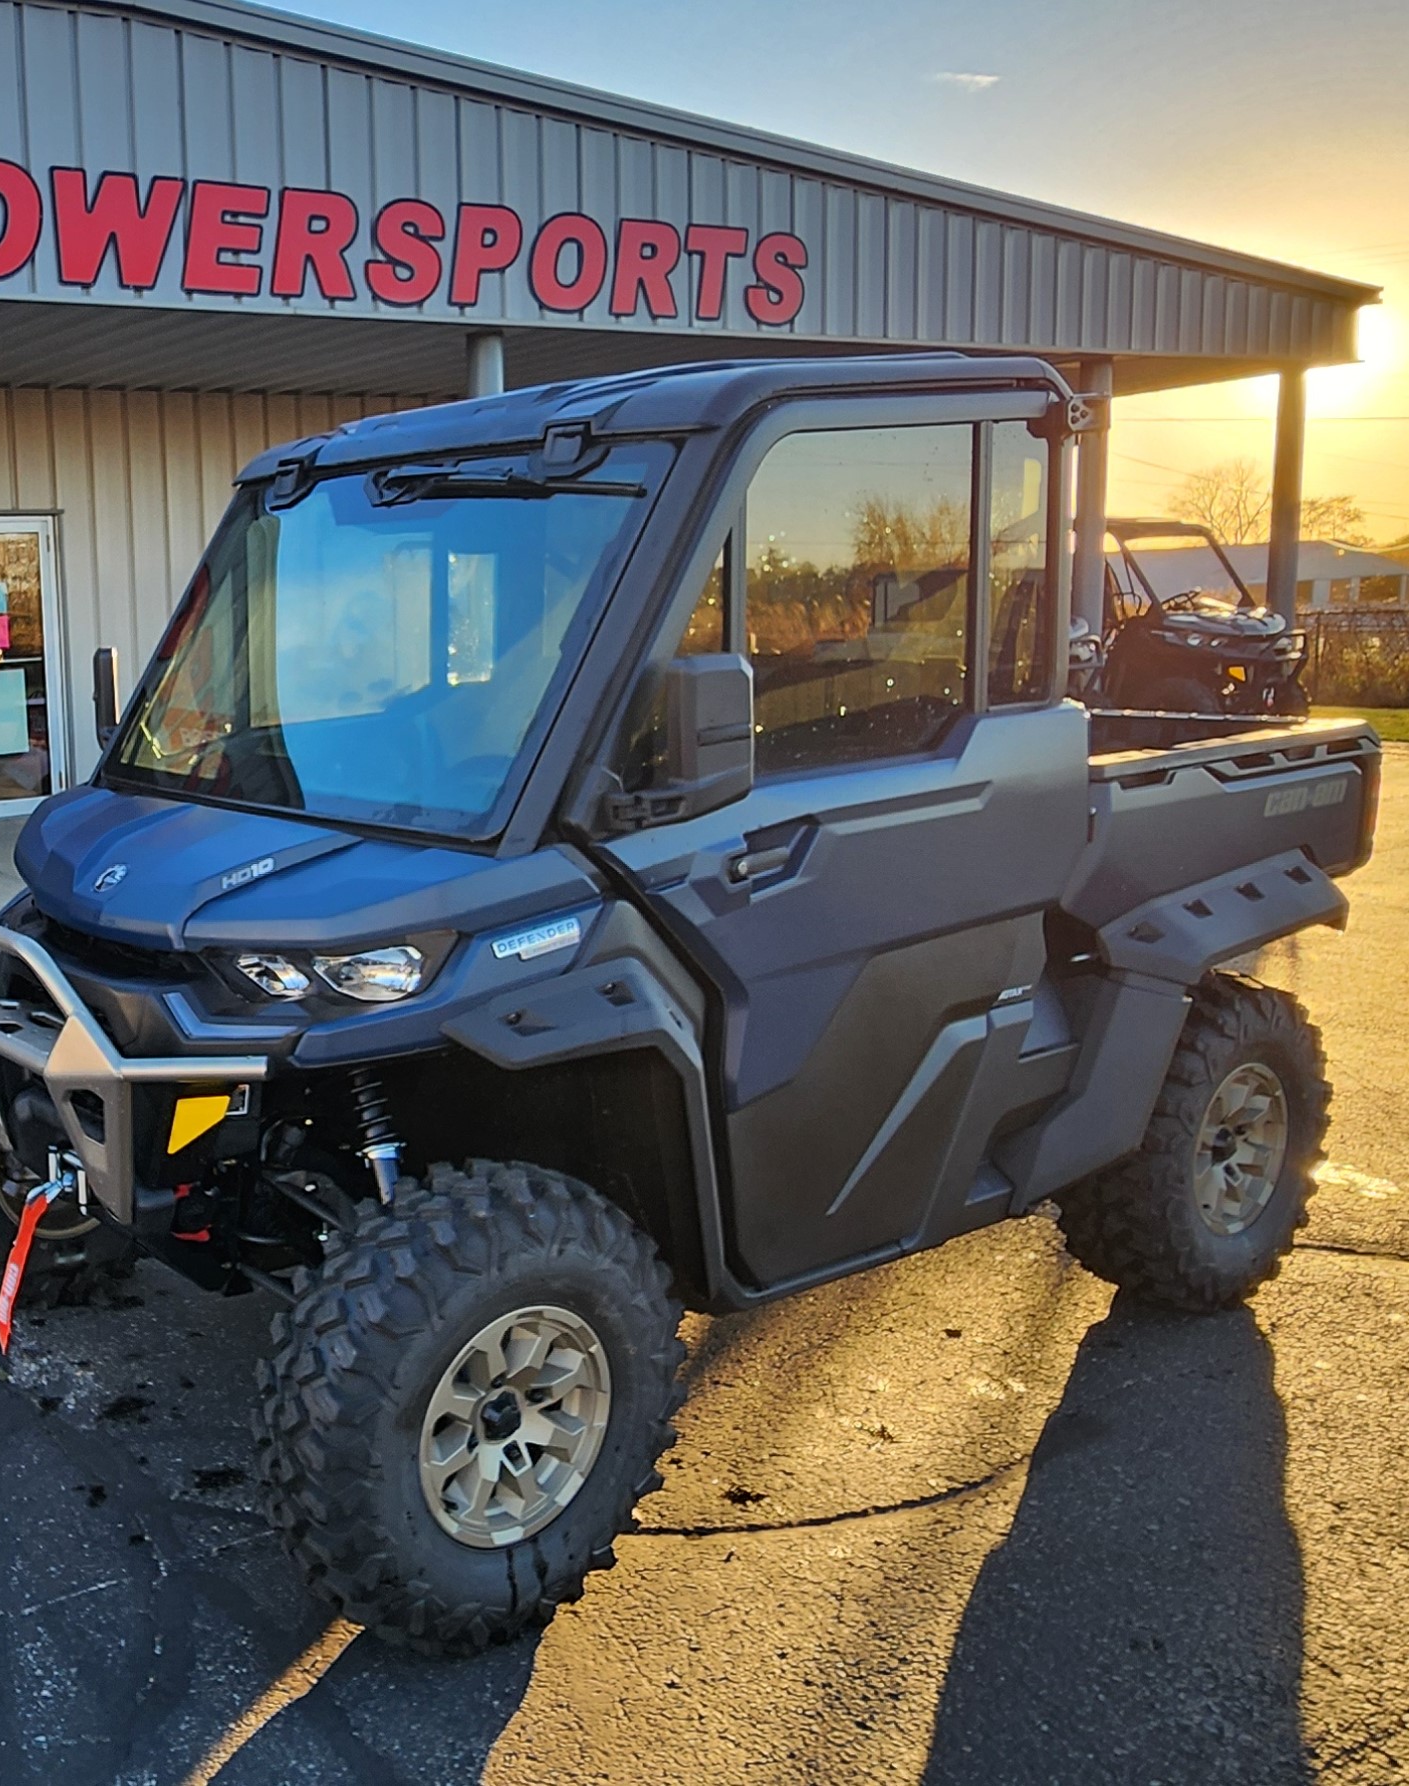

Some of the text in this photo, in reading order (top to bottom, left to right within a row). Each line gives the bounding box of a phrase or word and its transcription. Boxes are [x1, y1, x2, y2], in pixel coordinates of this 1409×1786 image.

[1263, 779, 1348, 817] can-am
[222, 857, 274, 889] HD10
[497, 921, 575, 953] DEFENDER
